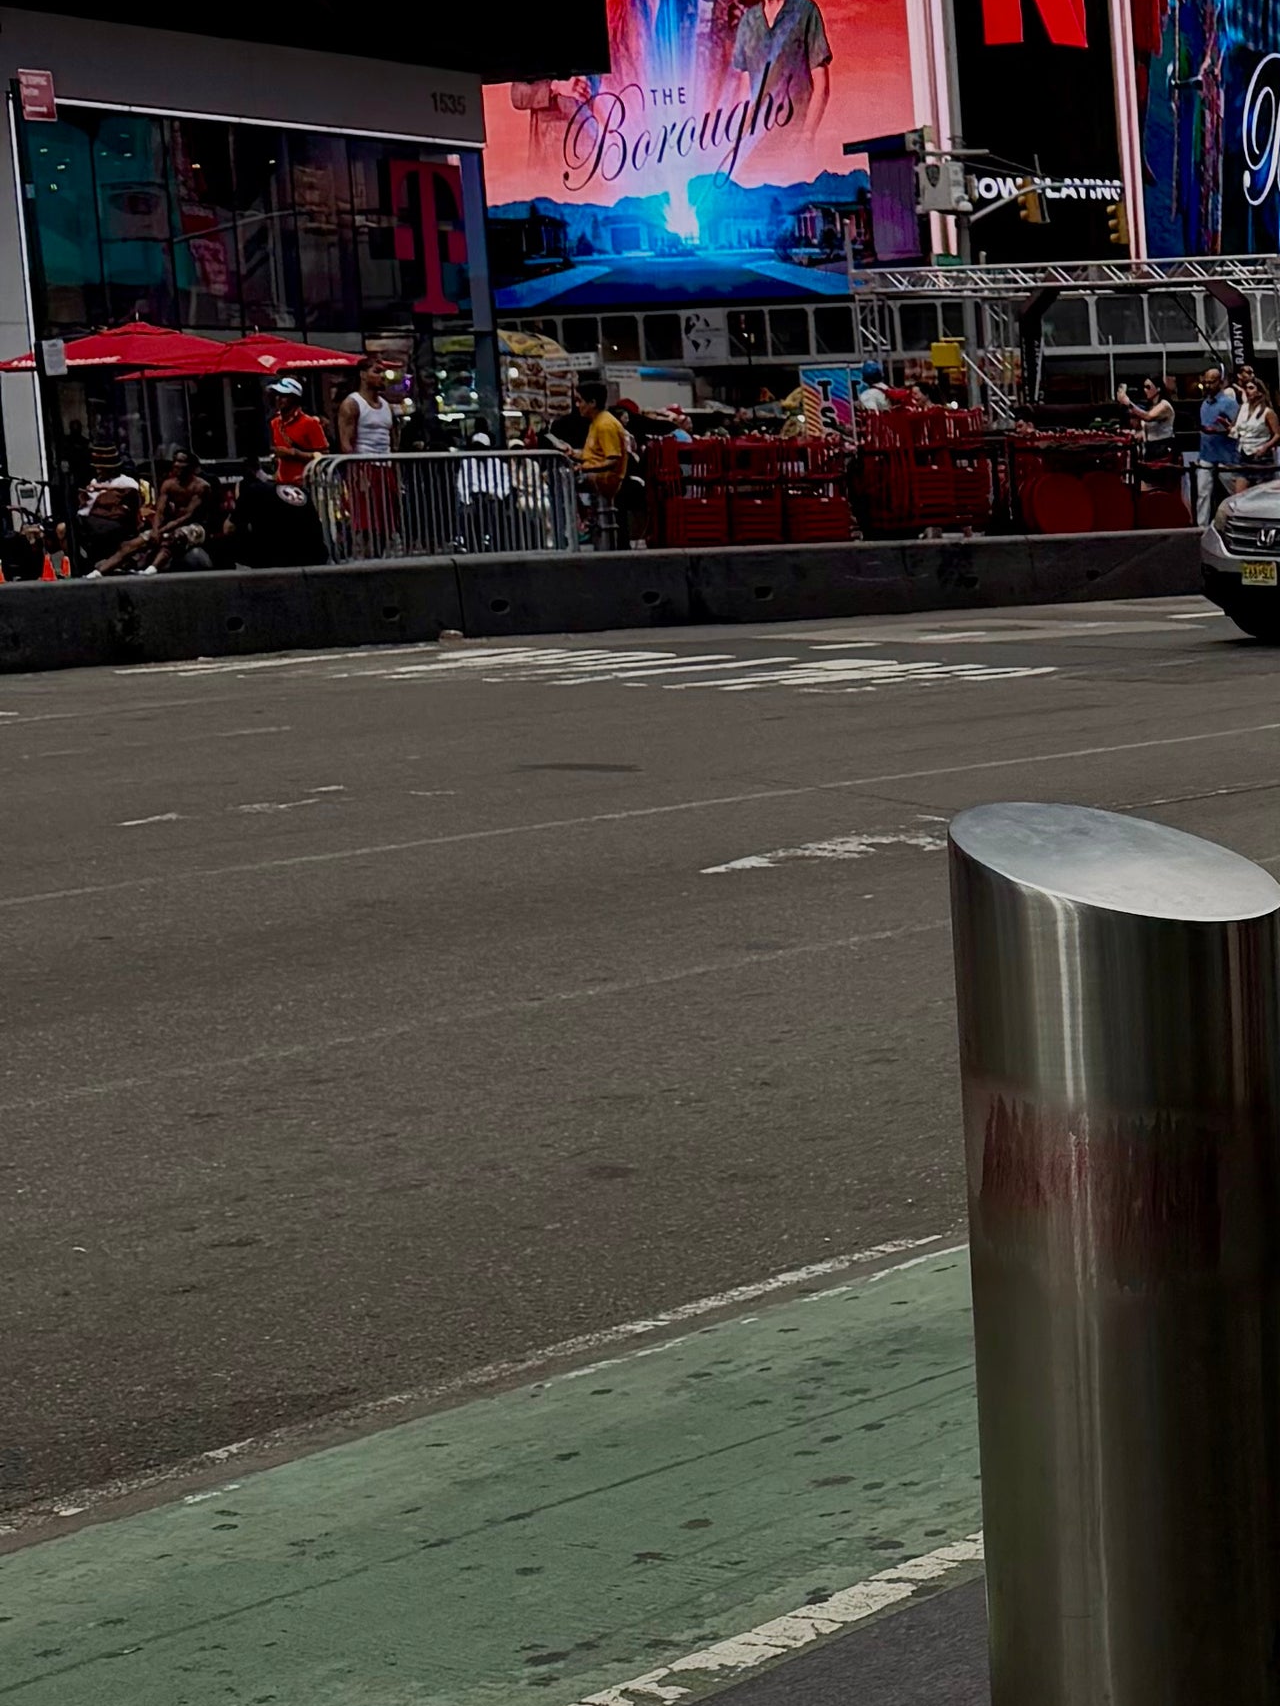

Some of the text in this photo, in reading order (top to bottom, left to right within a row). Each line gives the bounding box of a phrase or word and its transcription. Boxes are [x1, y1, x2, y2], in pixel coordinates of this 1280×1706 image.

[430, 91, 467, 116] 1535
[650, 86, 687, 106] THE
[562, 60, 795, 193] Boroughs
[976, 176, 1024, 200] OW
